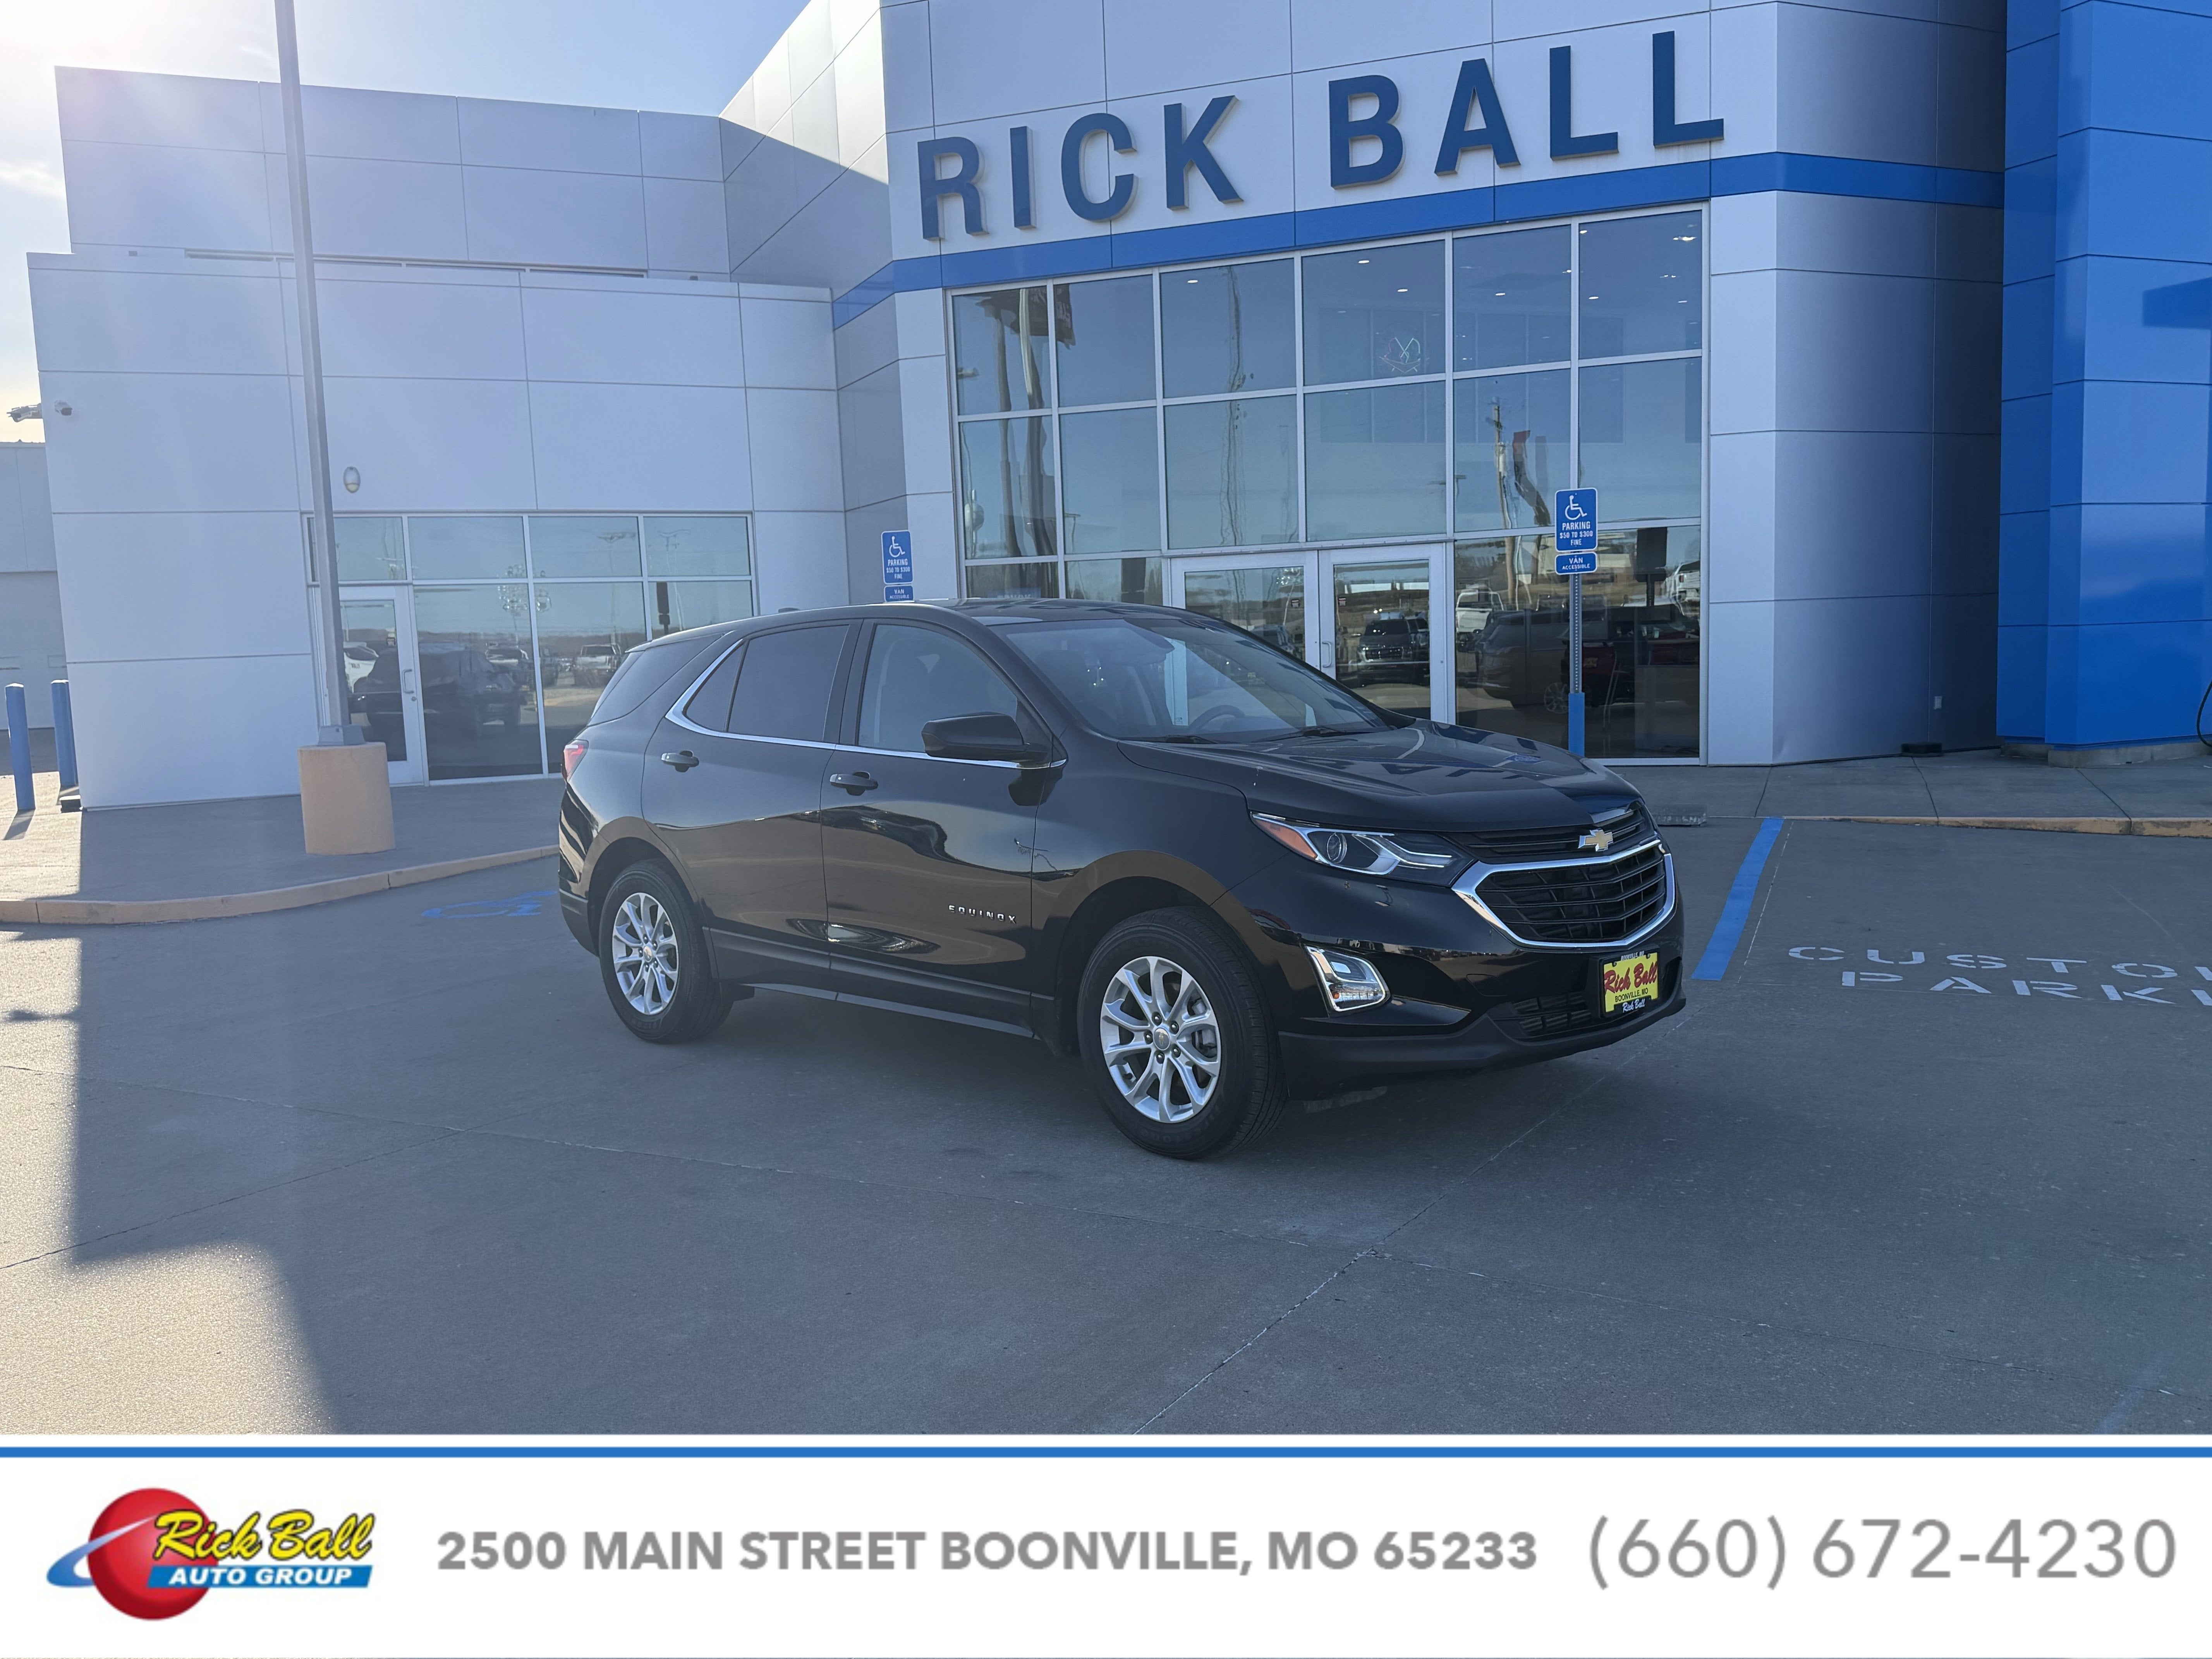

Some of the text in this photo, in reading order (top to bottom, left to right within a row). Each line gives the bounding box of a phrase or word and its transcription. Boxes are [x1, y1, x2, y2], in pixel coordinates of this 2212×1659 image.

[917, 30, 1724, 241] RICK BALL
[1562, 521, 1590, 531] PARKING
[949, 905, 1017, 924] EQUINOX
[1604, 961, 1658, 993] Rick Ball
[1622, 998, 1645, 1013] Rick Ball
